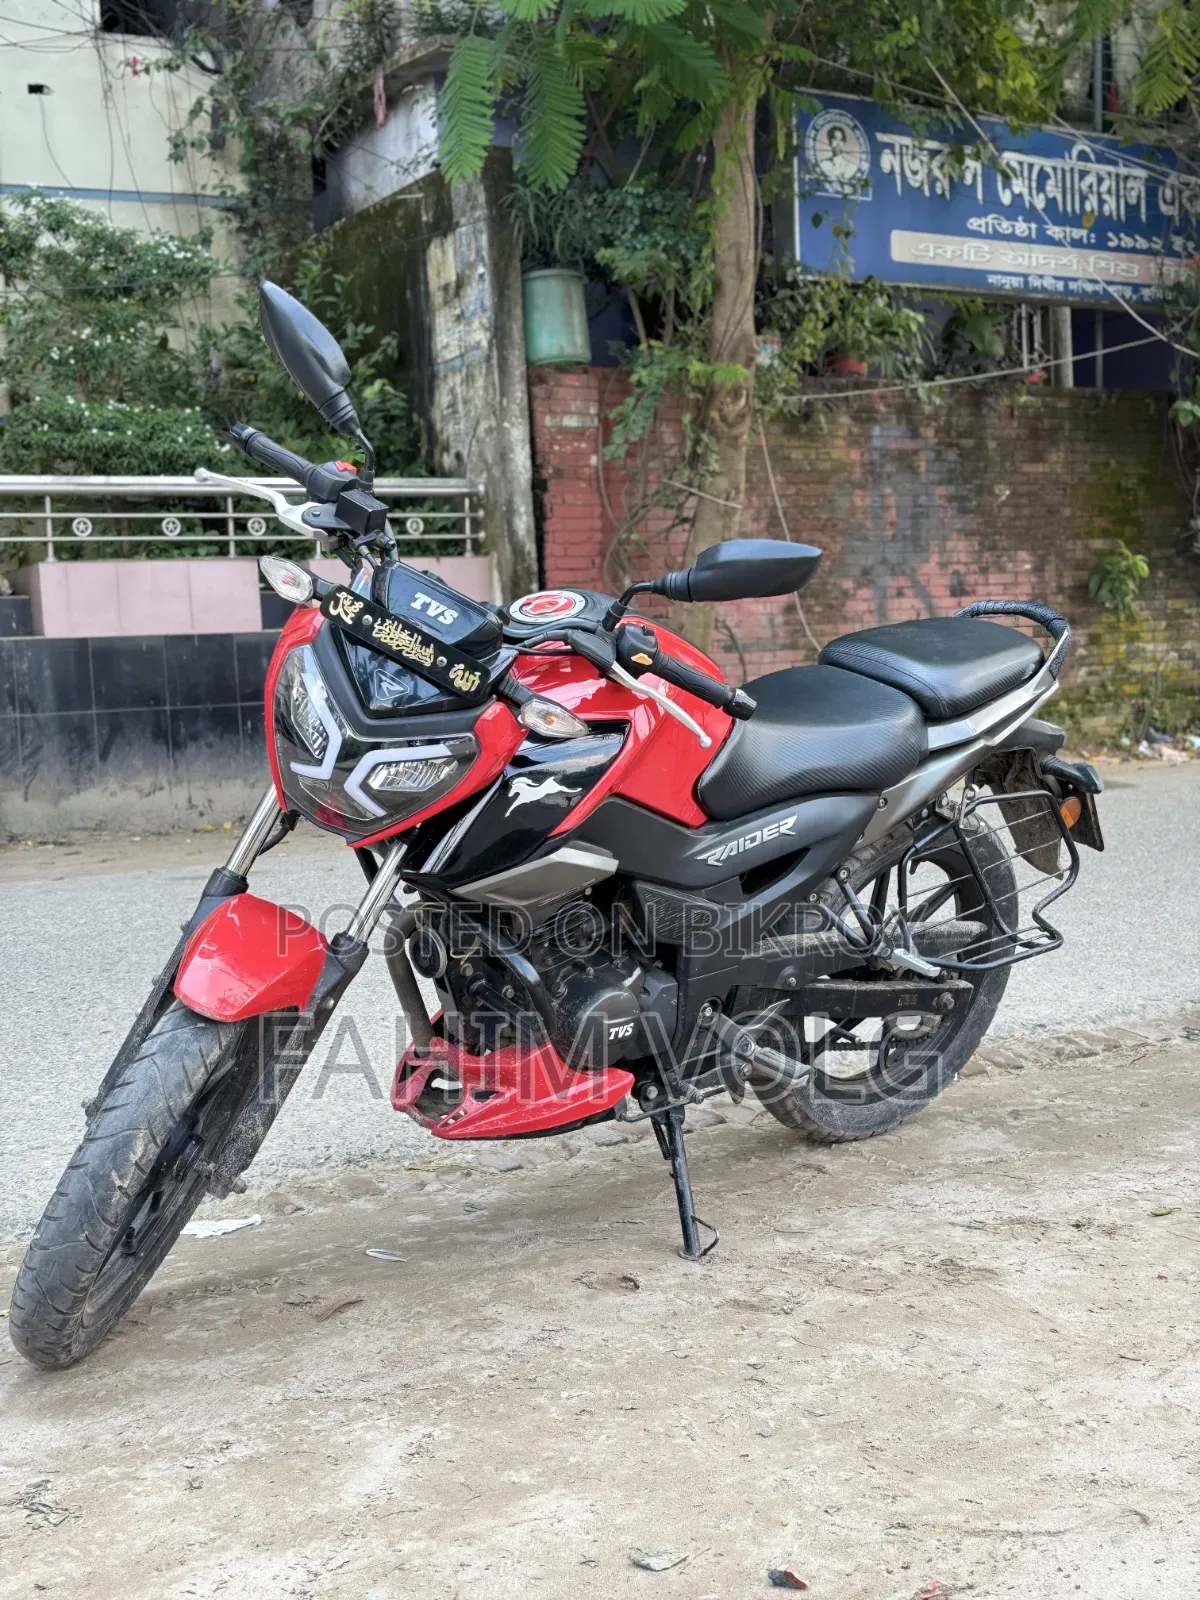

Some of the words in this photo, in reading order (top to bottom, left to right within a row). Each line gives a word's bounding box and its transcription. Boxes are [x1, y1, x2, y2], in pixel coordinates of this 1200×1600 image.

[966, 213, 1038, 239] প্রতিষ্ঠা
[1106, 230, 1164, 253] ১৯৯২
[911, 239, 993, 264] একটি
[410, 591, 459, 626] TVS
[694, 814, 799, 867] RAIDER
[608, 1022, 635, 1041] TVS
